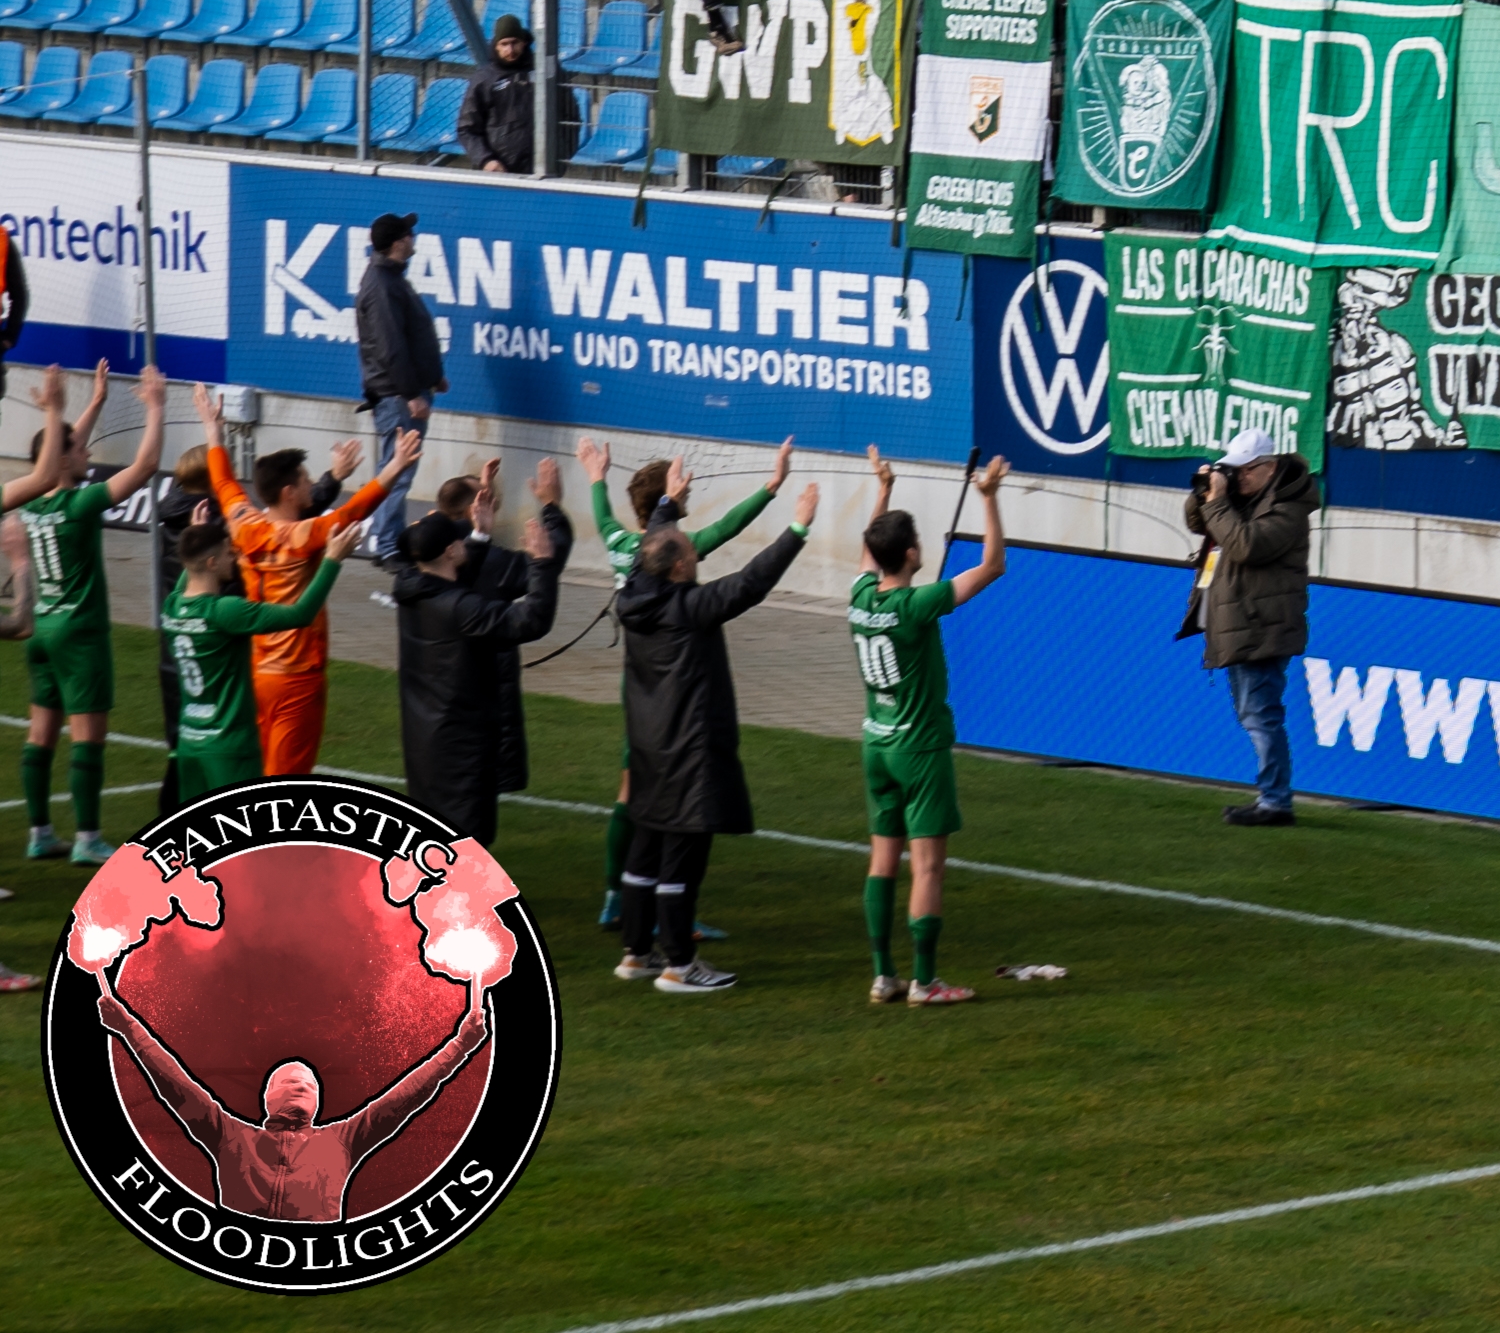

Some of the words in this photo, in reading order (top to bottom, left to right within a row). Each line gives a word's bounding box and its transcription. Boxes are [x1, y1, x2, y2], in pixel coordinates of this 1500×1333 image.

[944, 13, 1038, 46] SUPPORTERS
[1236, 17, 1449, 234] TRC
[542, 243, 932, 352] WALTHER
[1121, 246, 1165, 301] LAS
[473, 322, 564, 361] KRAN-
[574, 331, 639, 370] UND
[646, 338, 932, 401] TRANSPORTBETRIEB
[1126, 388, 1200, 449] CHEMI
[26, 524, 65, 582] 11
[853, 633, 902, 689] 10
